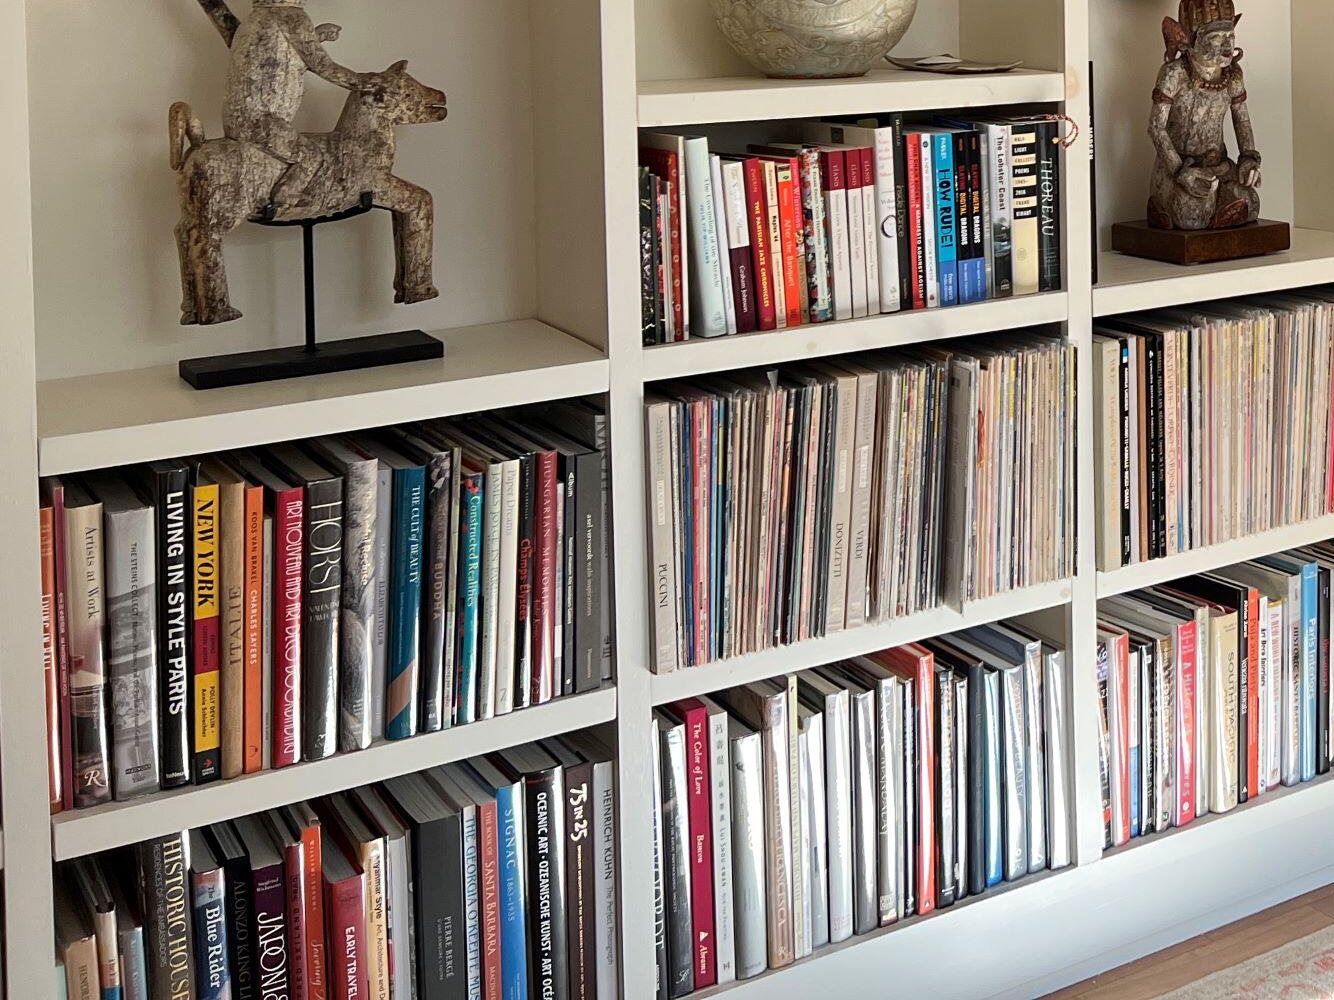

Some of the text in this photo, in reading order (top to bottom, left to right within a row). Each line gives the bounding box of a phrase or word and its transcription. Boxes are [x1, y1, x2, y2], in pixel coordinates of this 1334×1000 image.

[996, 136, 1006, 210] The Lobster Coast
[938, 168, 954, 248] HOW RUDE!
[1040, 158, 1054, 237] THOREAU
[753, 201, 770, 307] THE PARISIAN JAZZ CHRONICLES
[784, 219, 795, 287] After the Banquet
[738, 265, 750, 312] Graham Johnson
[286, 501, 302, 519] ART
[491, 472, 502, 507] JAMES
[504, 469, 516, 537] Paper Dreams
[285, 521, 302, 575] NOUVEAU
[309, 501, 342, 594] HORST
[408, 485, 421, 584] THE CULT of BEAUTY
[491, 511, 501, 541] JOYCE
[541, 459, 553, 615] HUNGARIAN MEMORIES
[586, 528, 594, 560] vervoordt
[855, 529, 864, 560] VERDI
[84, 527, 100, 619] Artists at Work
[196, 499, 215, 608] NEW YORK
[466, 496, 480, 608] Constructed Realities
[490, 549, 501, 561] IN
[834, 523, 844, 578] DONIZETTI
[166, 492, 186, 715] LIVING IN STYLE PARIS
[285, 579, 302, 600] AND
[432, 562, 443, 621] BUDDHA
[584, 578, 593, 617] inspirations
[658, 564, 668, 609] PUCCINI
[229, 586, 242, 666] ITALIE
[250, 590, 258, 629] CHARLES
[285, 602, 302, 622] ART
[376, 580, 386, 646] ELIZABETH TAYLOR
[1249, 617, 1257, 643] Puja
[250, 632, 258, 665] SAYERS
[284, 626, 300, 662] DECO
[1308, 618, 1317, 699] Paris Interiors
[1249, 663, 1257, 692] Piety
[209, 706, 217, 729] DEVLIN
[693, 723, 702, 739] The
[1227, 652, 1236, 765] SOUTH PACIFIC
[692, 766, 703, 774] of
[693, 741, 703, 764] Color
[570, 783, 588, 806] 75
[694, 776, 703, 795] Love
[536, 792, 547, 835] OCEANIC
[570, 819, 588, 841] 25
[573, 806, 584, 820] IN
[504, 809, 516, 921] SIGNAC 1863-1935
[538, 839, 549, 854] ART
[163, 838, 186, 937] HISTORIC
[538, 861, 551, 919] OZEANISCHE
[206, 887, 224, 988] The Blue Rider
[234, 880, 252, 982] ALONZO KING
[444, 915, 455, 979] PIERRE BERGÉ
[540, 920, 552, 951] KUNST
[542, 959, 552, 976] ART
[699, 944, 709, 975] Abrams
